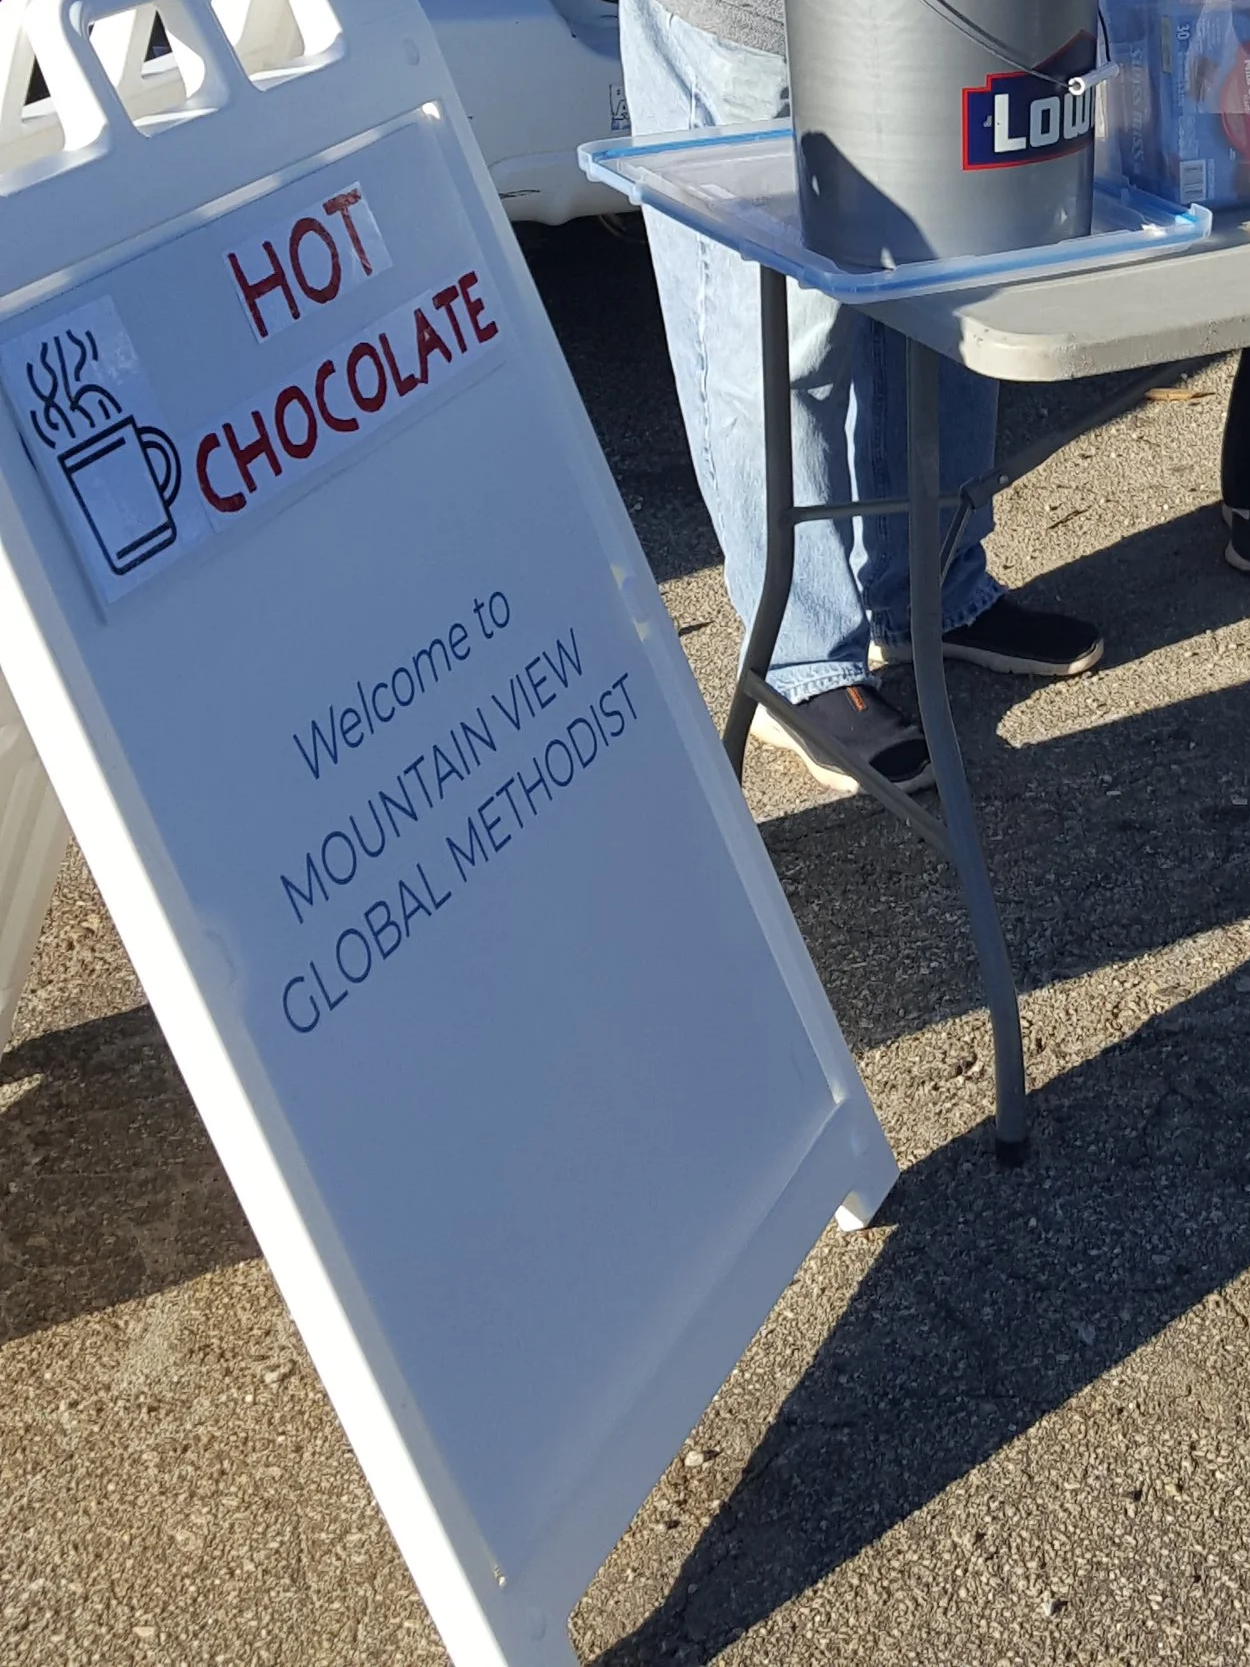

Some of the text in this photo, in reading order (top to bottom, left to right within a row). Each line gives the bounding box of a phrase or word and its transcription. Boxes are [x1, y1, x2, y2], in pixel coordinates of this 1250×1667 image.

[994, 89, 1094, 153] LOW
[1176, 24, 1190, 40] 30
[226, 190, 374, 337] HOT
[196, 271, 499, 514] CHOCOLATE
[280, 627, 583, 924] MOUNTAIN VIEW
[293, 591, 511, 780] Welcome to
[282, 672, 638, 1034] GLOBAL METHODIST
